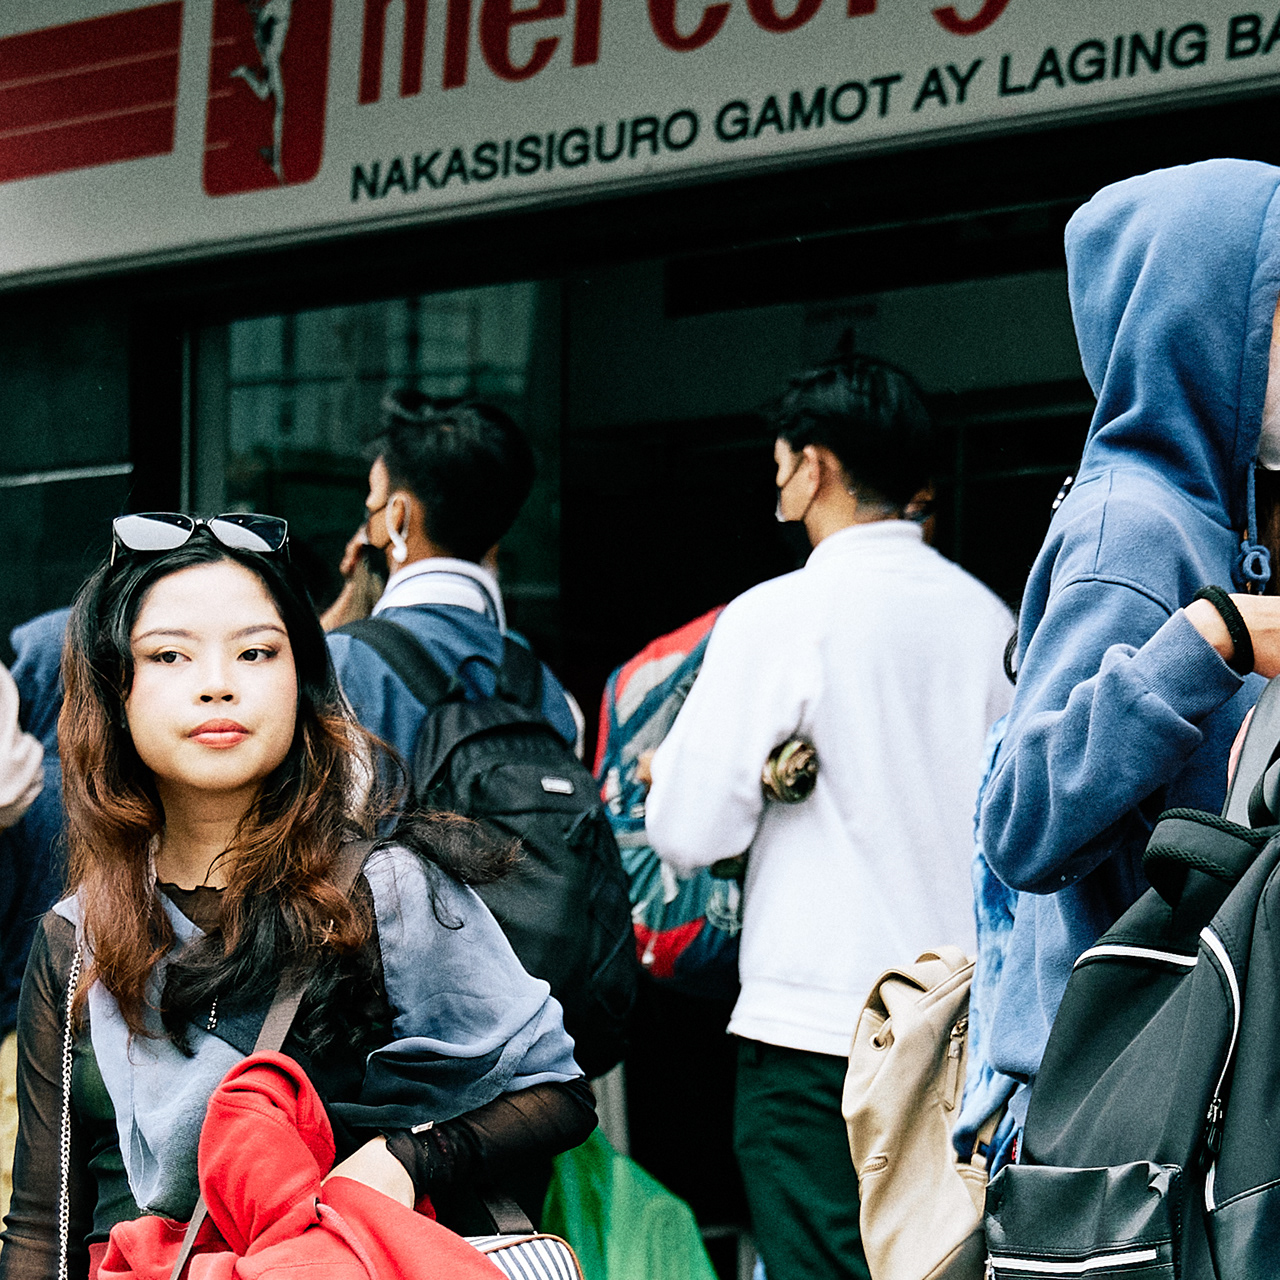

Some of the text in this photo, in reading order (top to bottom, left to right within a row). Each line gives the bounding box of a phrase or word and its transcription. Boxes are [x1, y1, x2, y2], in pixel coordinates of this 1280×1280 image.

[350, 108, 699, 203] NAKASISIGURO
[715, 73, 904, 143] GAMOT
[913, 58, 984, 112] AY
[998, 22, 1208, 96] LAGING
